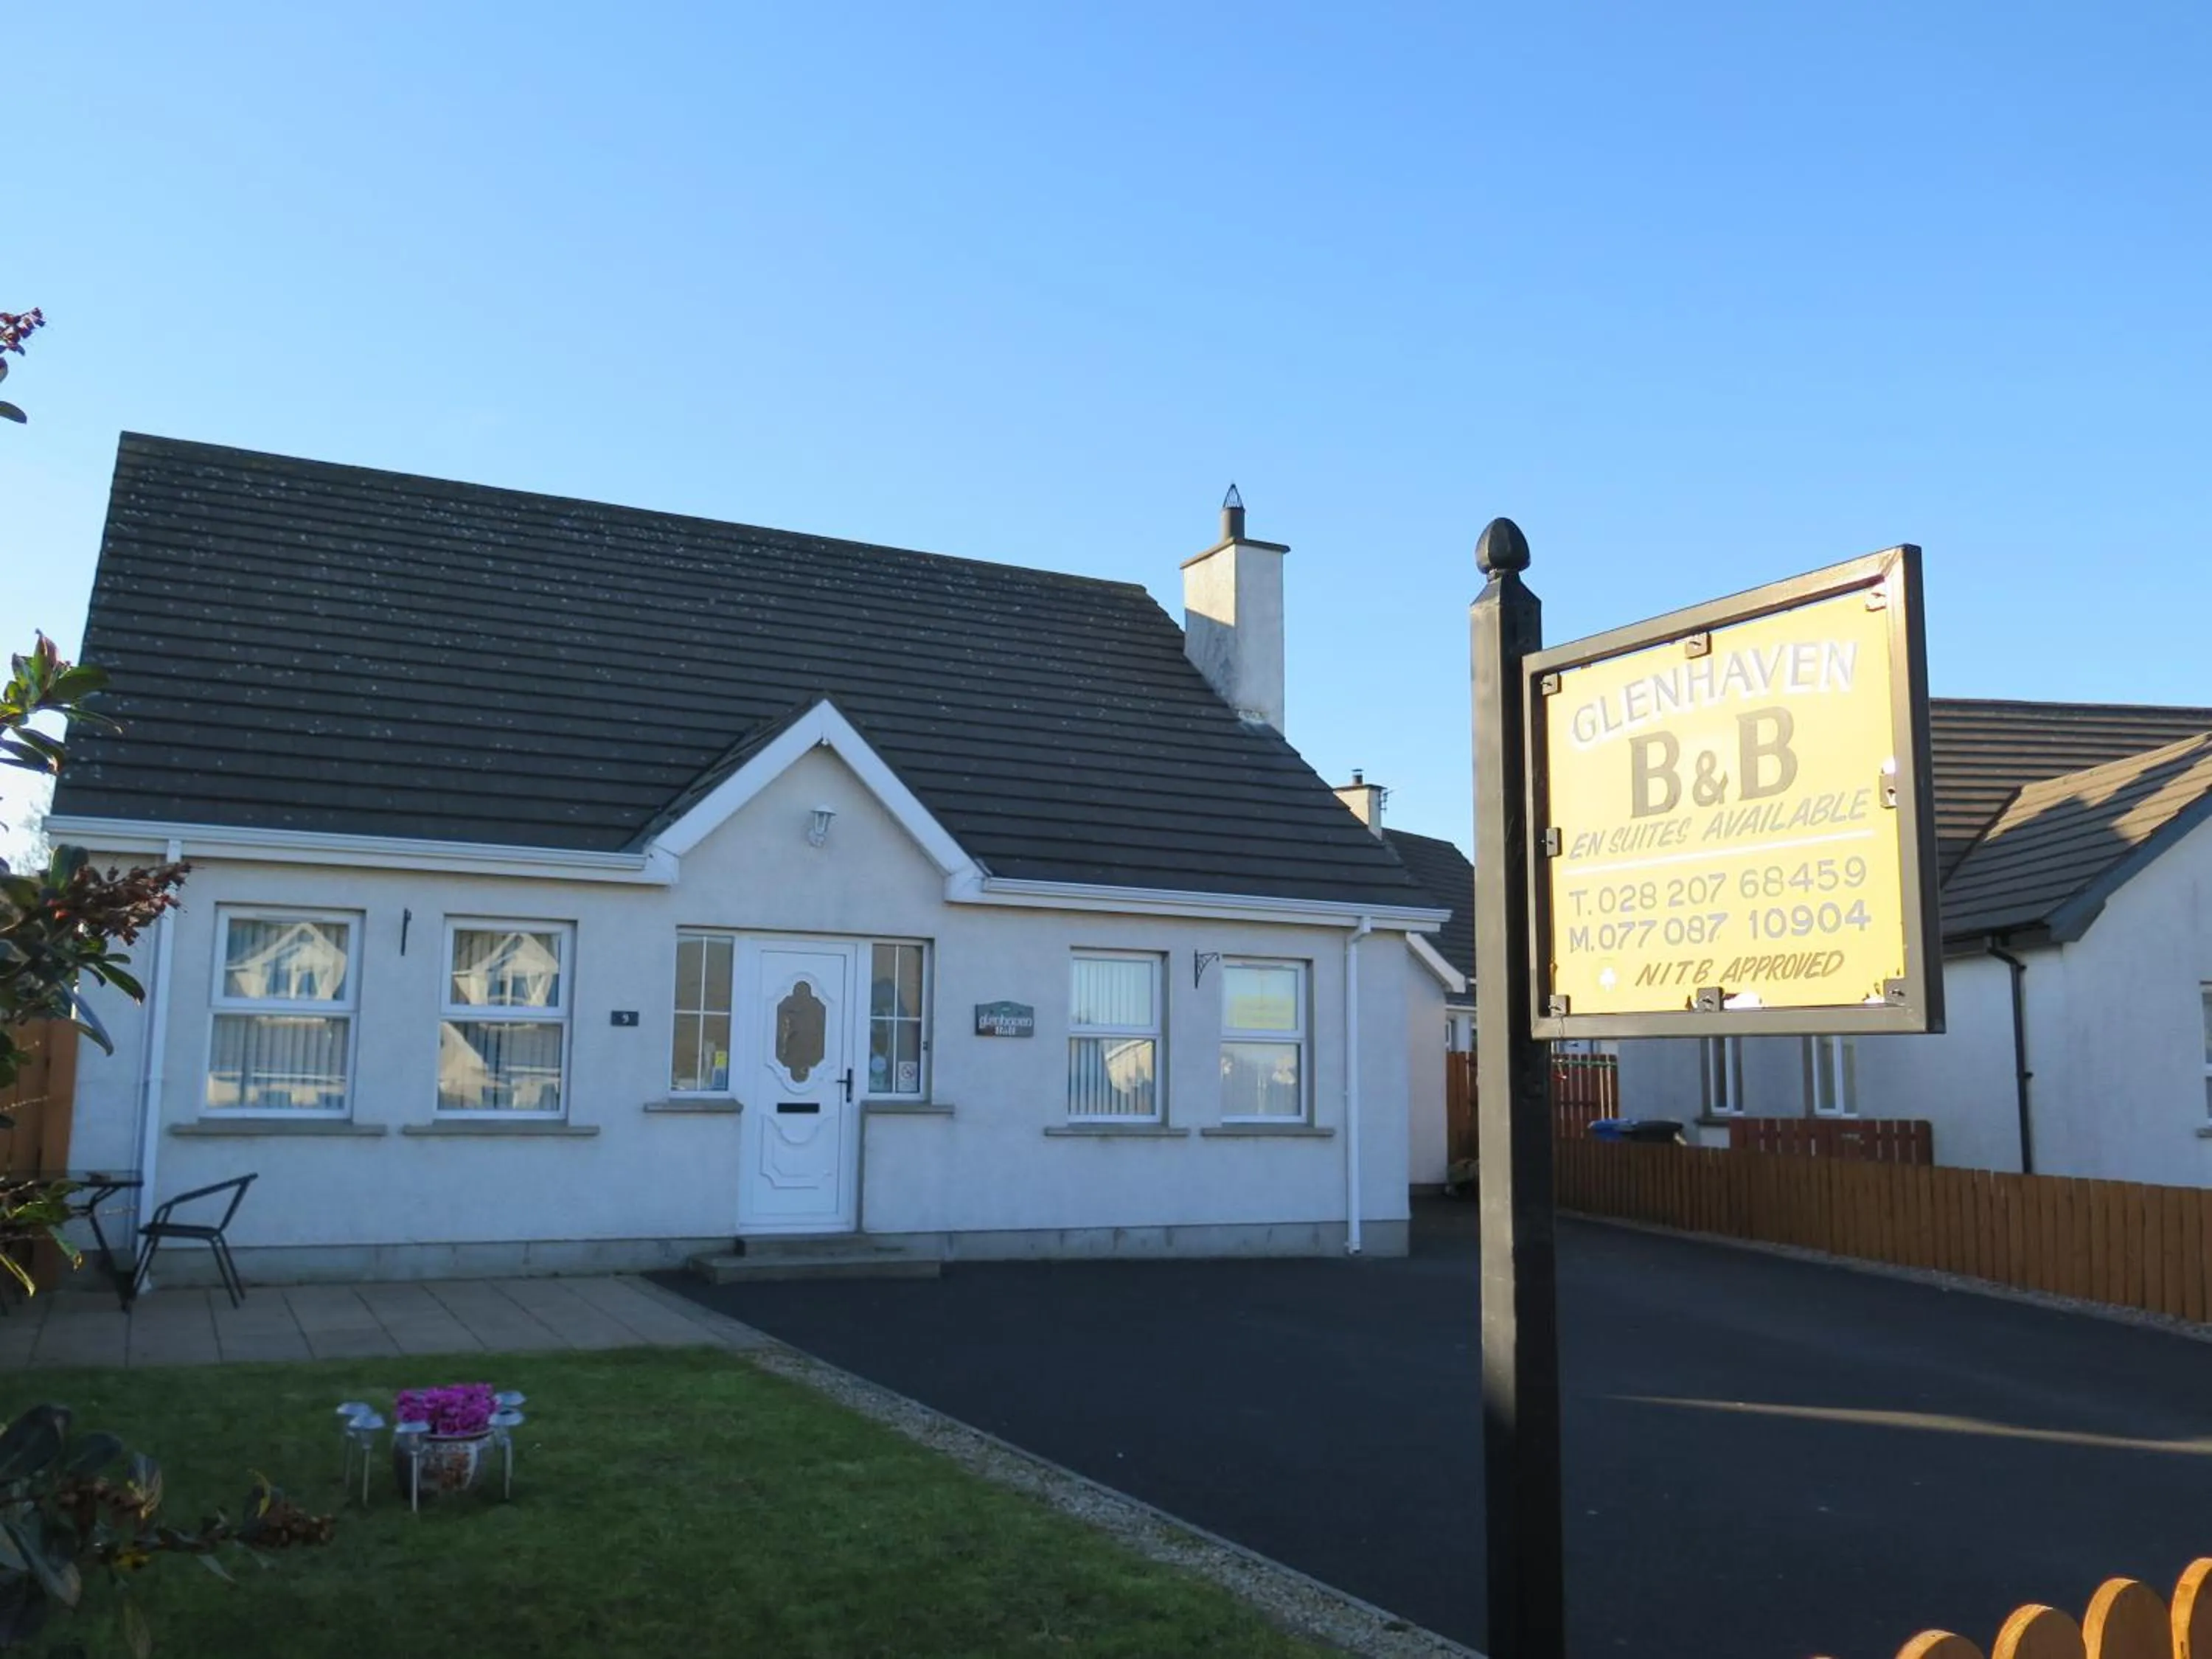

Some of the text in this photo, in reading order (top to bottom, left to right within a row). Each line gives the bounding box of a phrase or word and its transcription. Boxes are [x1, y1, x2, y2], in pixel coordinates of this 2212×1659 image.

[1571, 642, 1857, 743] GLENHAVEN
[1628, 706, 1798, 819] B&B
[1568, 788, 1871, 860] EN SUITES AVAILABLE
[1667, 872, 1727, 908] 207
[1739, 855, 1867, 900] 68459
[1663, 912, 1728, 947] 087
[1748, 898, 1871, 940] 10904
[1719, 950, 1845, 984] APPROVED
